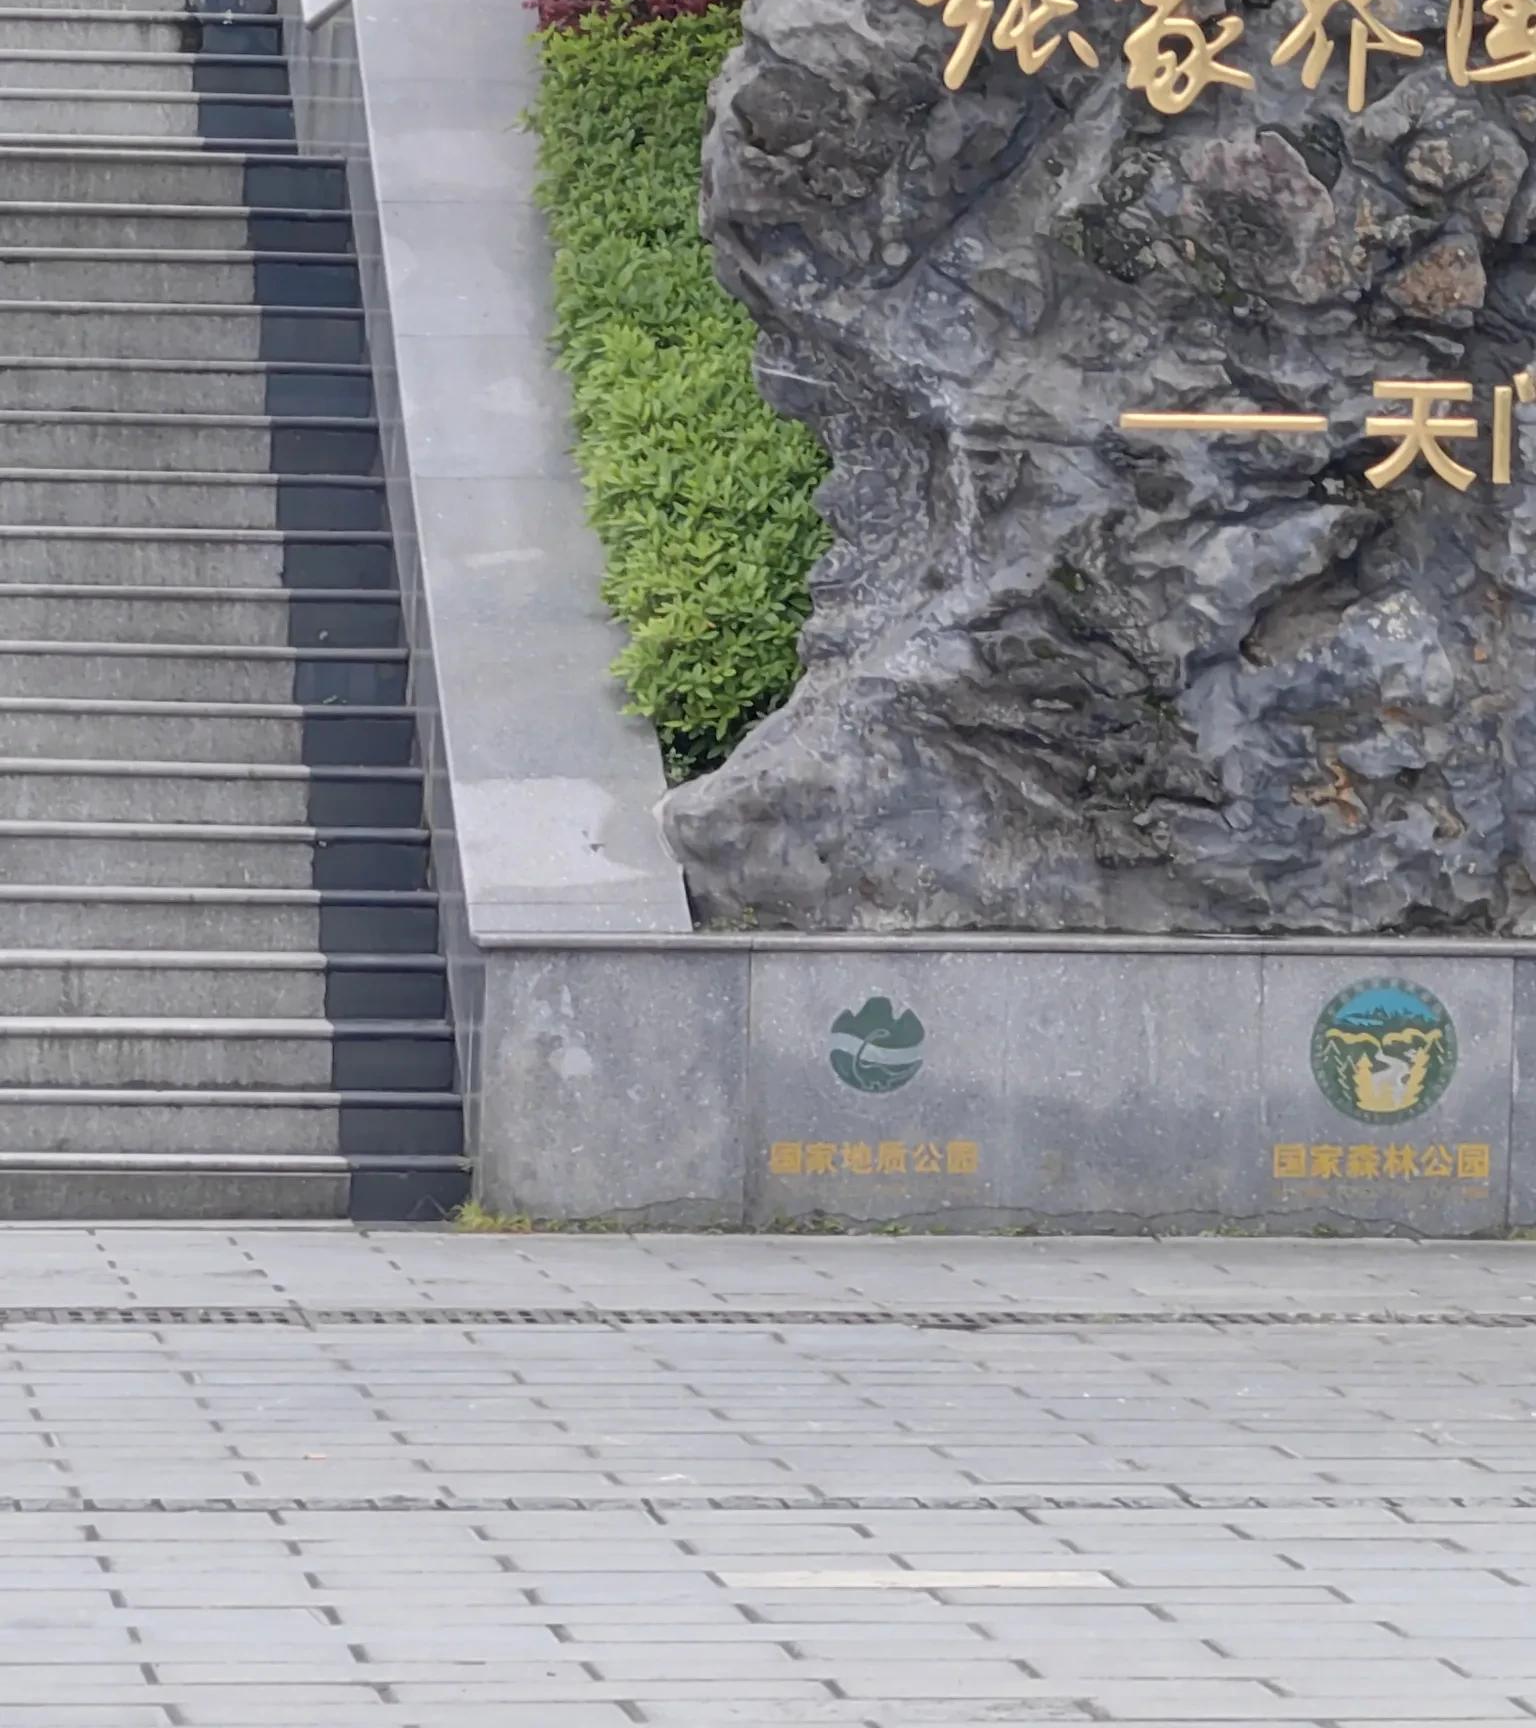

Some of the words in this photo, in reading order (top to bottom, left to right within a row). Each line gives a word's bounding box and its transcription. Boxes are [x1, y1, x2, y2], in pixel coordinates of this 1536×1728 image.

[769, 1140, 979, 1175] 国家地质公园
[1273, 1142, 1490, 1181] 国家森林公园
